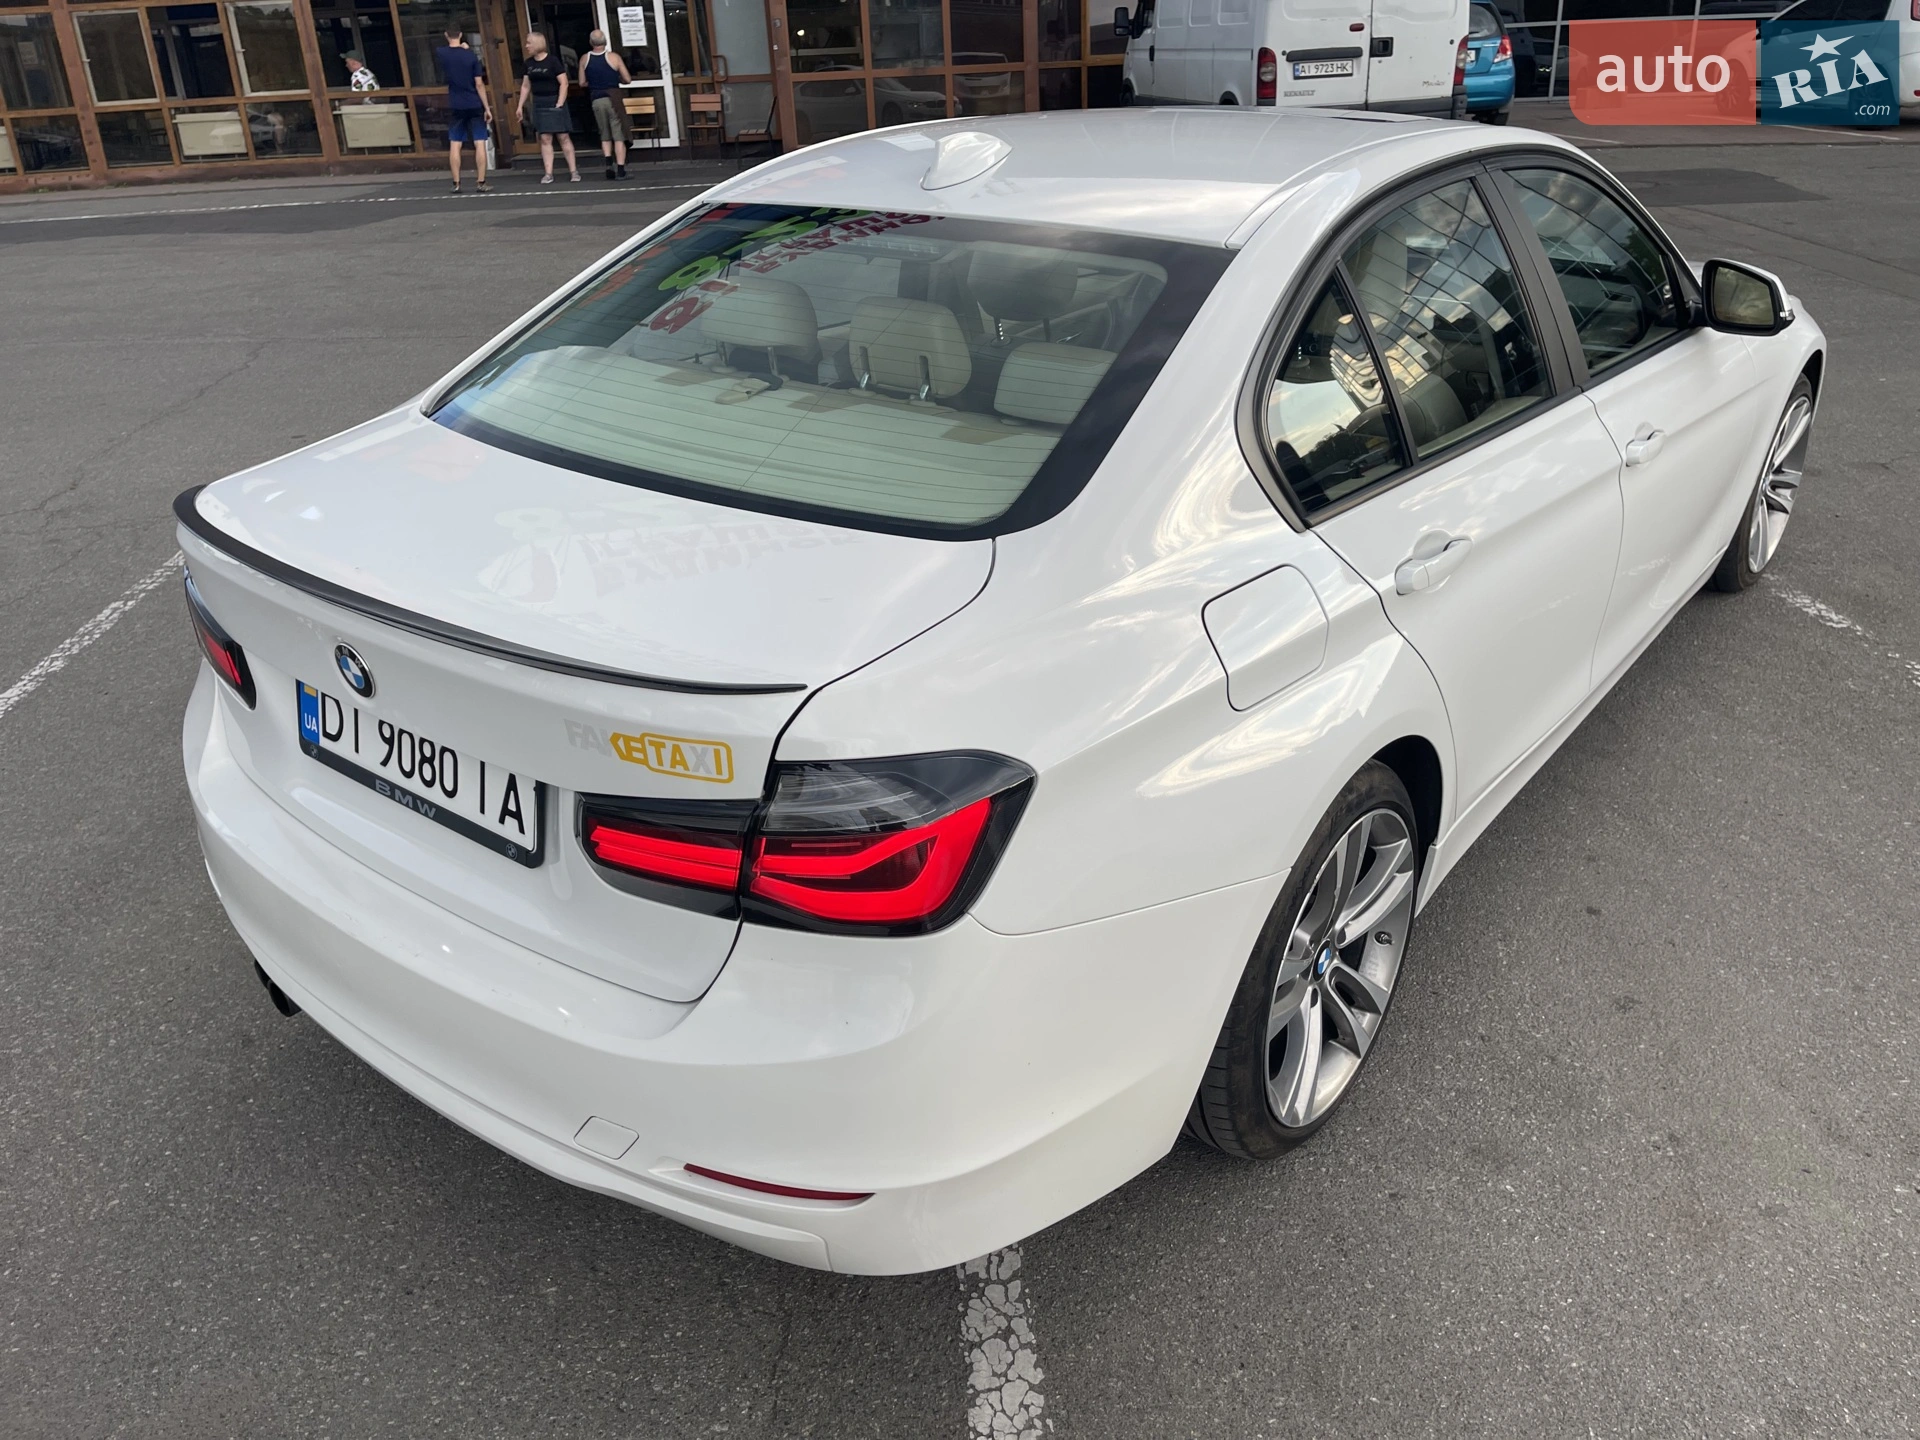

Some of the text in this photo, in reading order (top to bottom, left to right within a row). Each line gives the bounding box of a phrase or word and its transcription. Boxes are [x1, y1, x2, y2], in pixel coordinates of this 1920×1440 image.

[1300, 62, 1349, 75] AI 9723 HK
[304, 712, 319, 734] UA
[321, 691, 526, 835] DI 9080 IA
[375, 778, 437, 820] BMW
